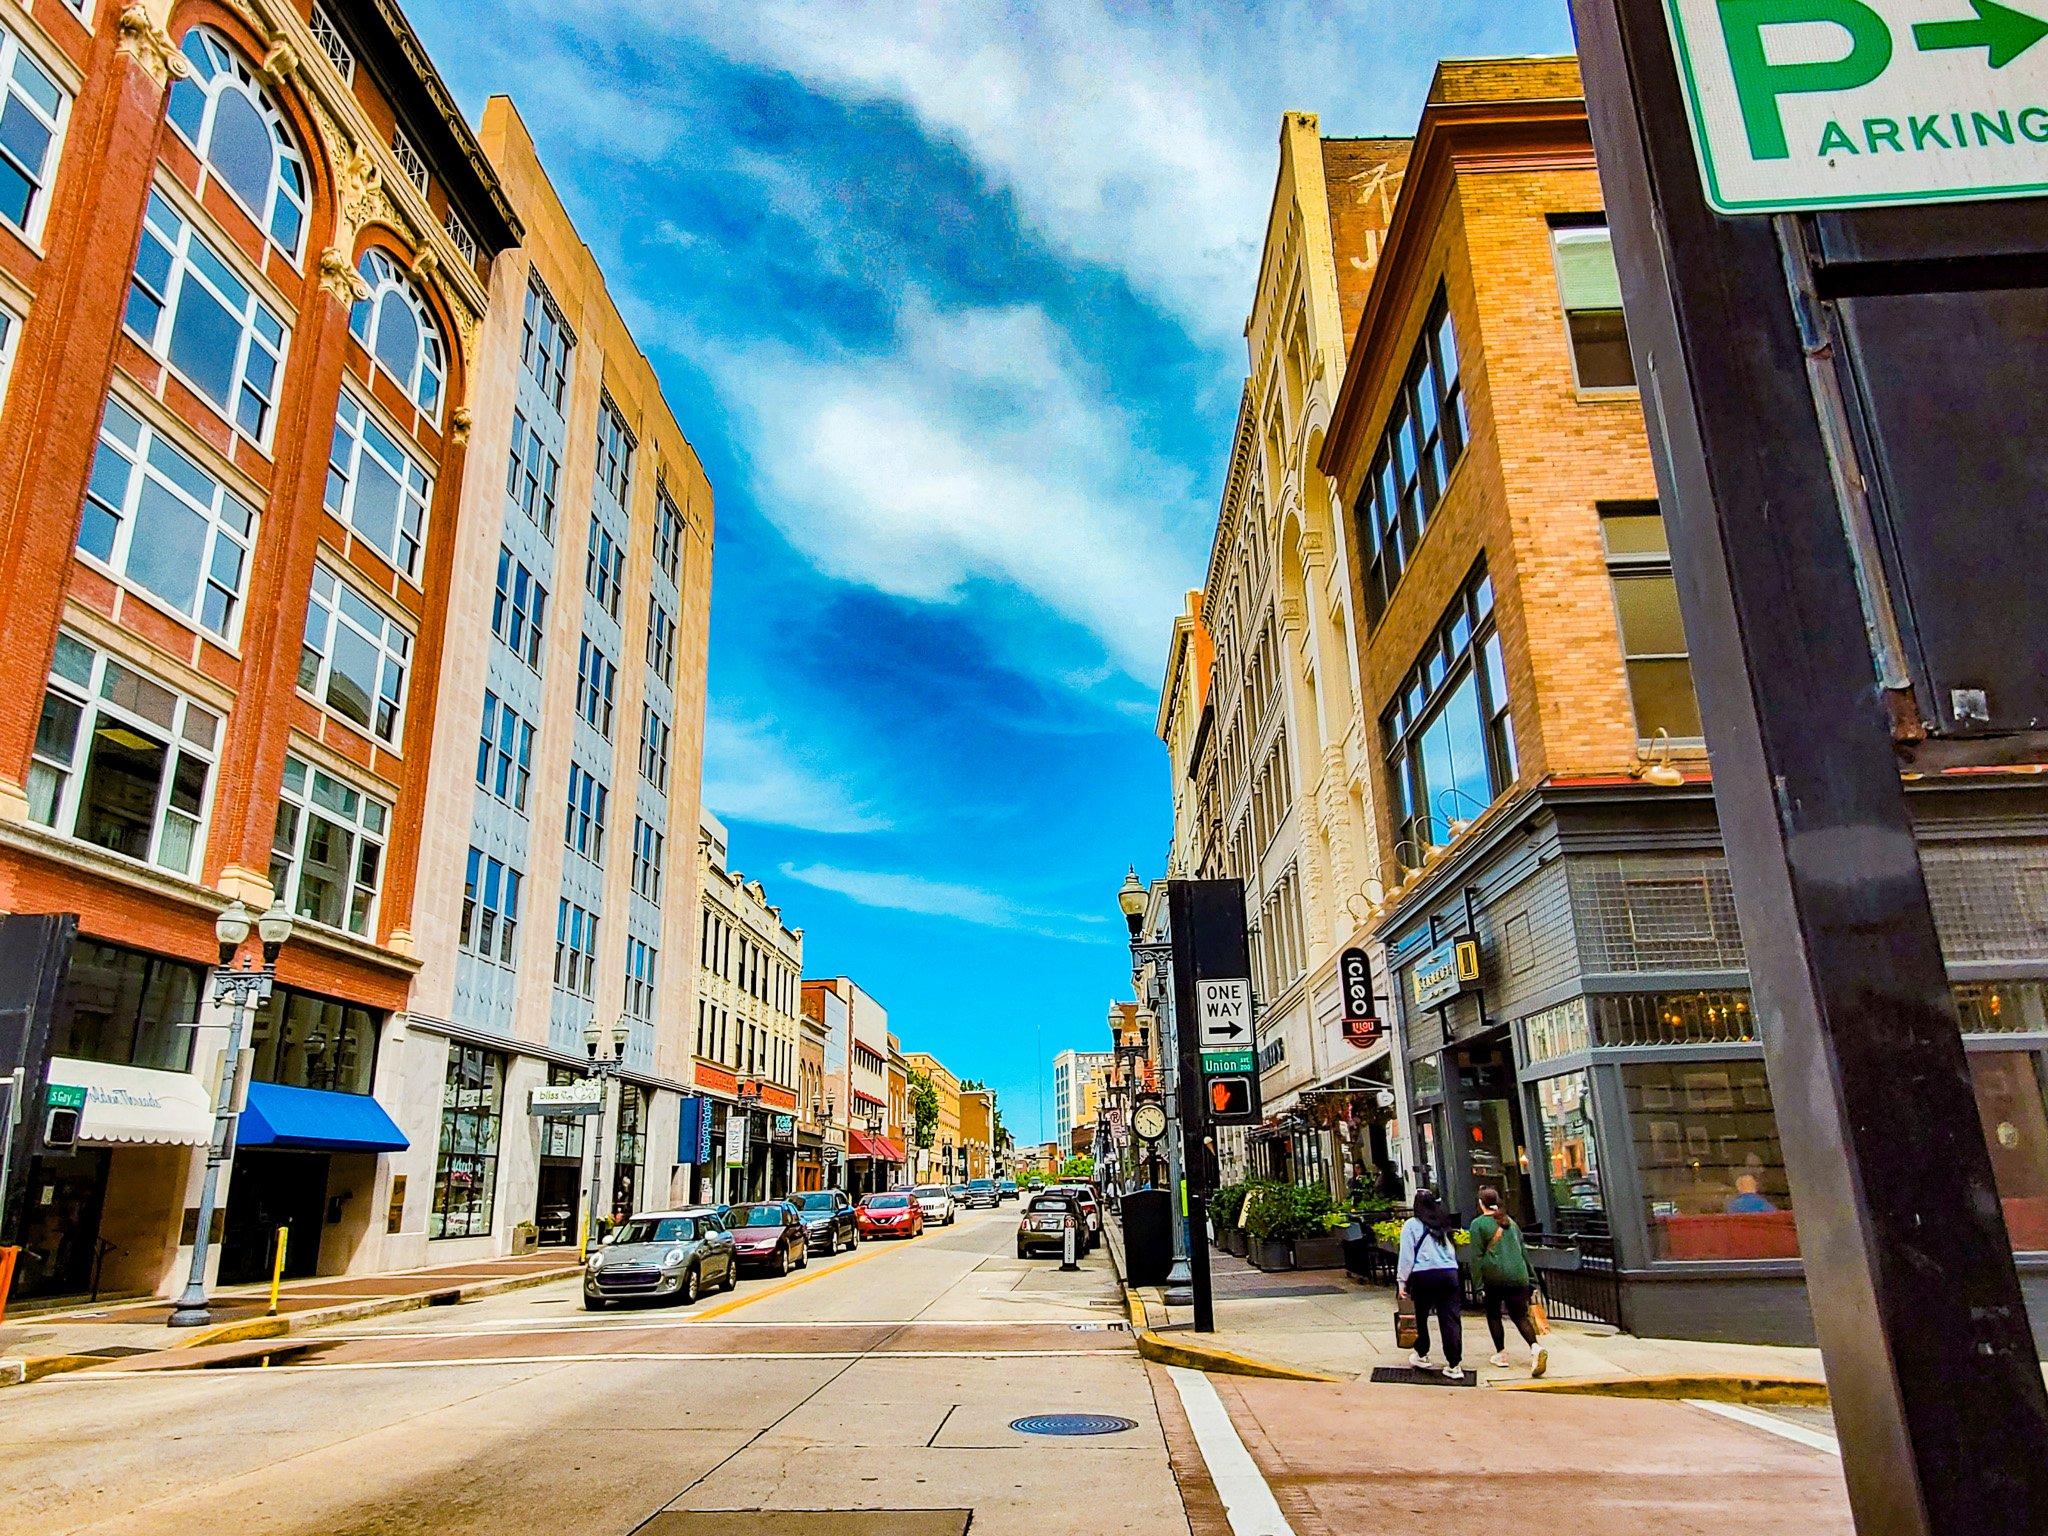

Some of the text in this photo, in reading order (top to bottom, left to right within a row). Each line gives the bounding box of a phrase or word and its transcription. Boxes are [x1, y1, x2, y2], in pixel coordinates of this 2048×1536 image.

[1207, 985, 1241, 1000] ONE
[1207, 1002, 1242, 1017] WAY
[1205, 1060, 1237, 1072] Union
[52, 1091, 58, 1101] S
[58, 1090, 72, 1106] Gay
[539, 1090, 559, 1100] bliss
